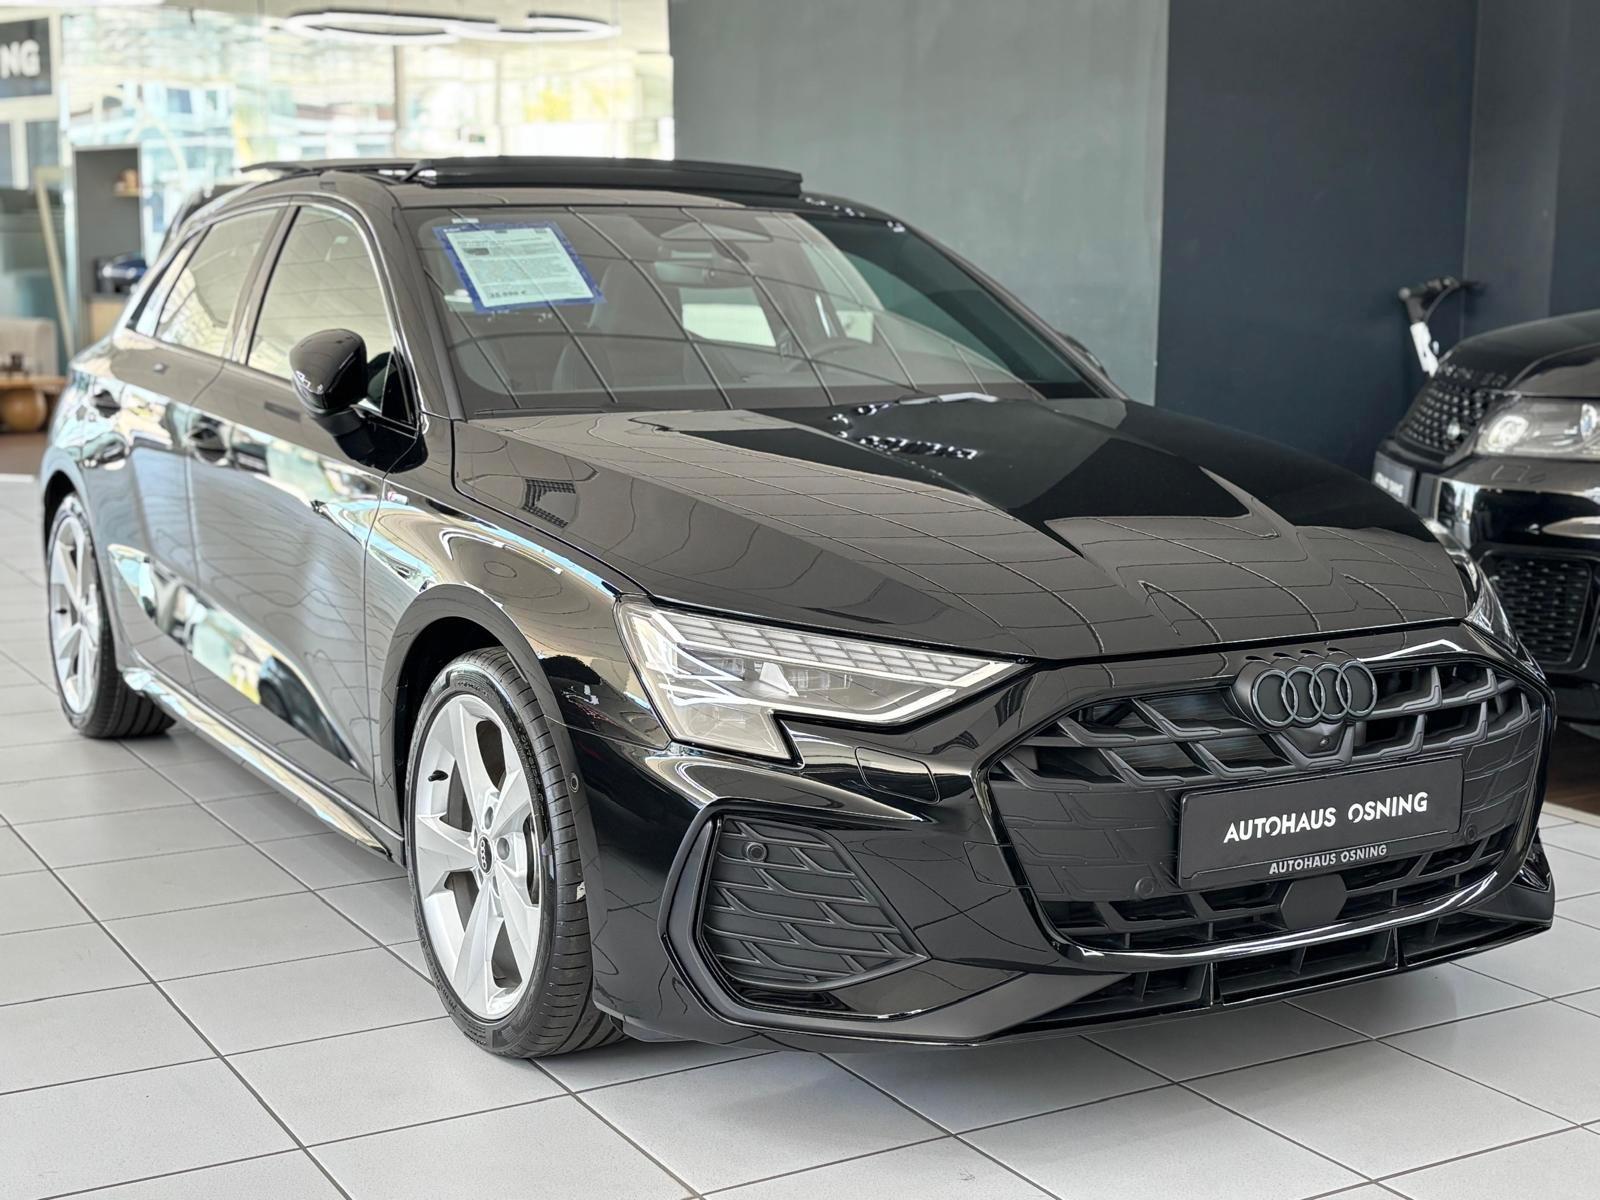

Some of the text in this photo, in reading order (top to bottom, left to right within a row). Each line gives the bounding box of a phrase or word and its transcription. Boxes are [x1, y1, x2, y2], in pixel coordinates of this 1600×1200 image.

[1223, 791, 1429, 843] AUTOHAUS OSNING
[1268, 844, 1387, 875] AUTOHAUS OSNING
